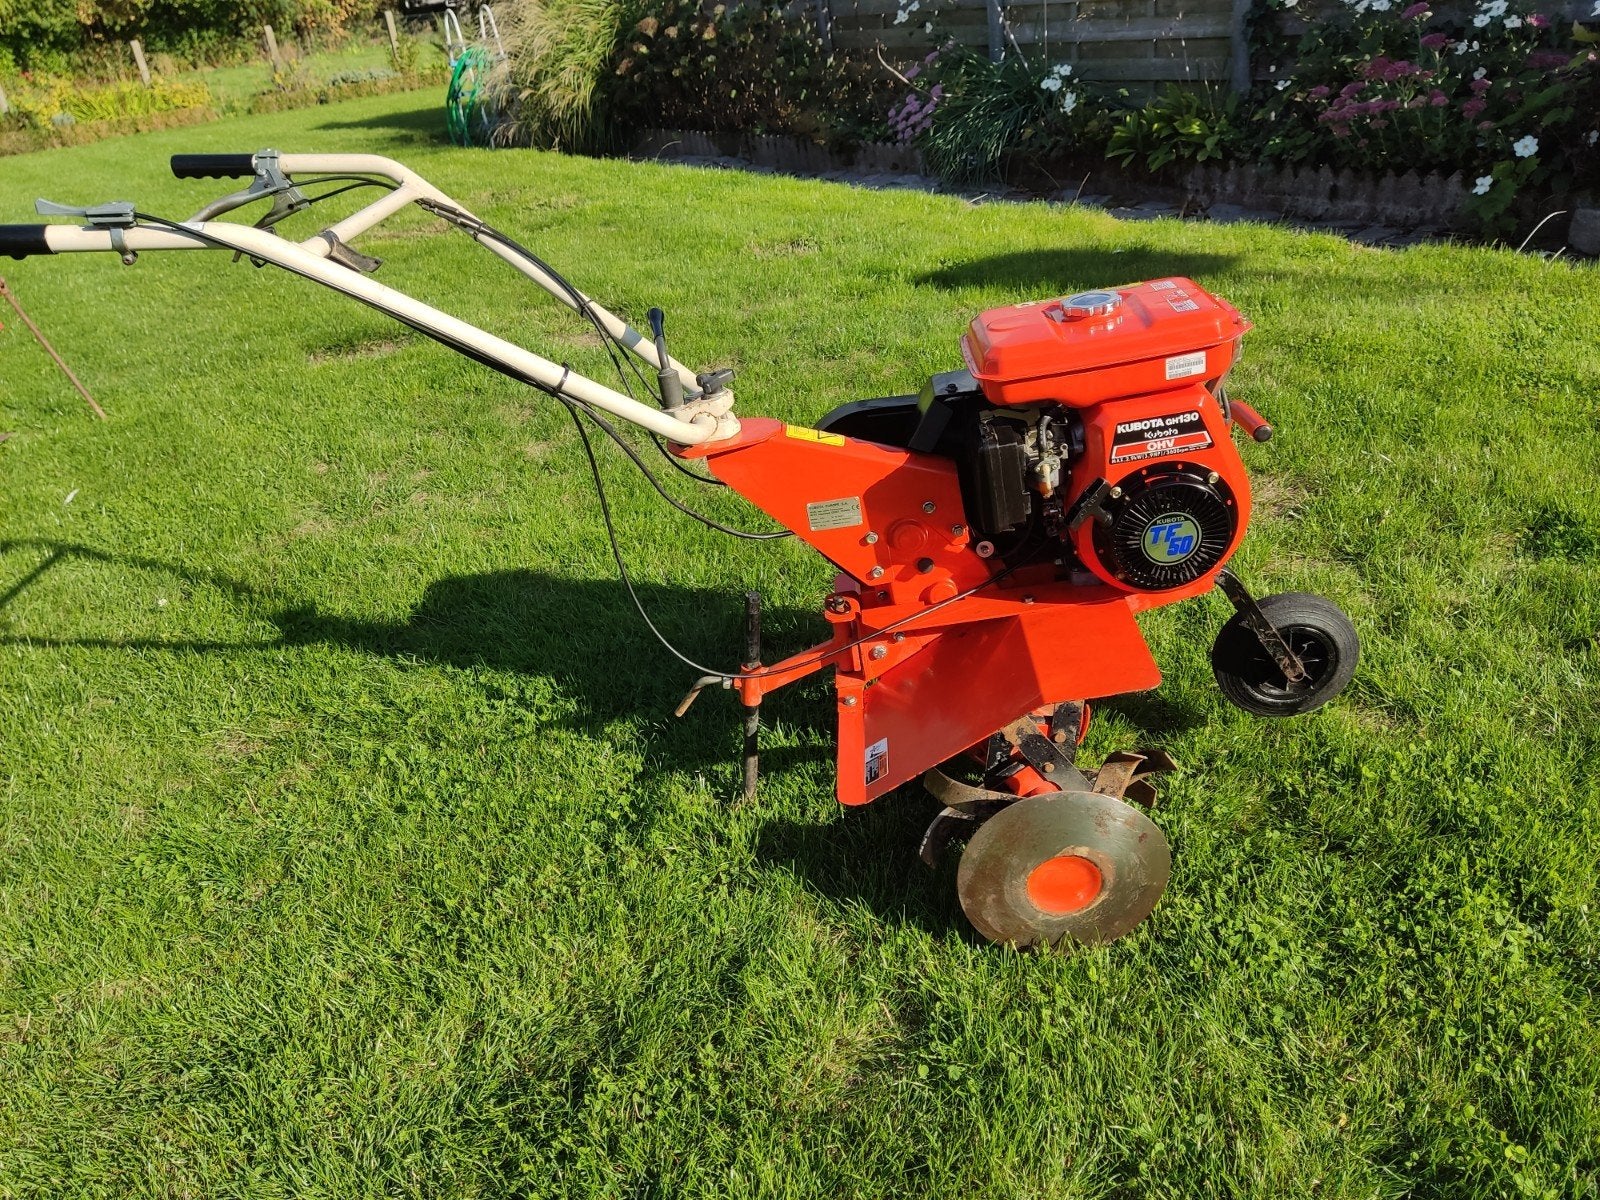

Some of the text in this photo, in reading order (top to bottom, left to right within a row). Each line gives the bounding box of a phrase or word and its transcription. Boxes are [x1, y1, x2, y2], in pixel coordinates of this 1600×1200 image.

[1117, 418, 1164, 434] KUBOTA
[1144, 428, 1179, 439] Kubota
[1147, 438, 1175, 451] OHV
[1156, 516, 1185, 525] KUBOTA
[1150, 522, 1183, 544] TF
[1167, 535, 1193, 556] 50
